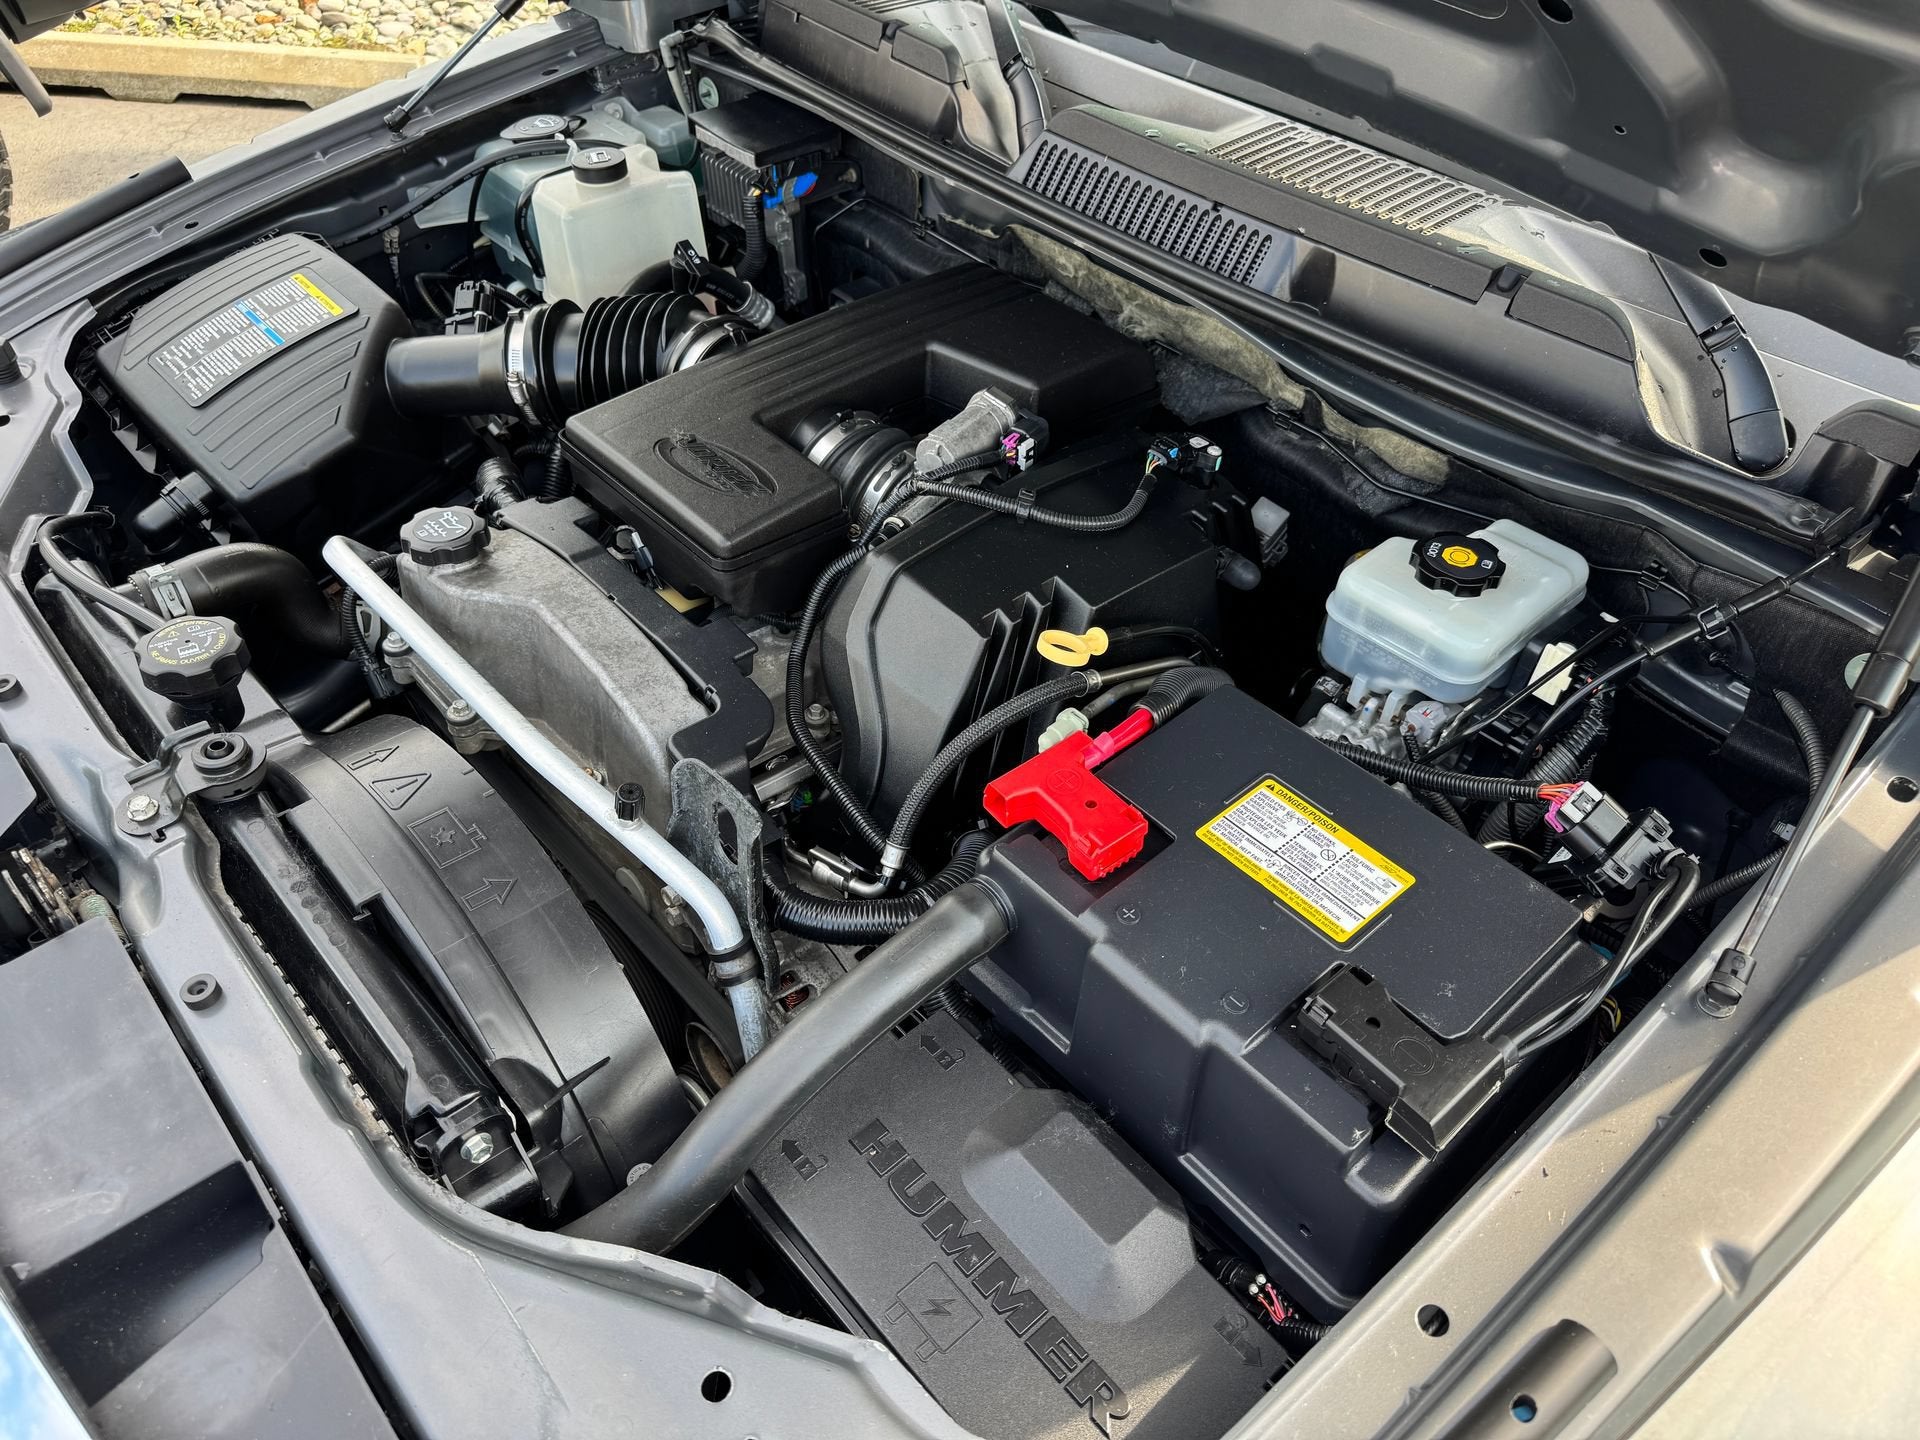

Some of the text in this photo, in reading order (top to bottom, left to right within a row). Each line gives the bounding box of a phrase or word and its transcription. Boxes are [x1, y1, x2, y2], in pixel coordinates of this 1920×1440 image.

[180, 652, 211, 664] OUVRIR
[1253, 794, 1279, 812] EXPLOSIVE
[1257, 790, 1275, 803] SHIELD
[1275, 788, 1339, 834] DANGER/POISON
[1302, 832, 1324, 849] SMOKING
[1305, 830, 1324, 843] FLAMES
[1244, 836, 1274, 859] IMMEDIATELY
[1348, 854, 1376, 873] SULFURIC
[848, 1117, 1131, 1440] HUMMER
